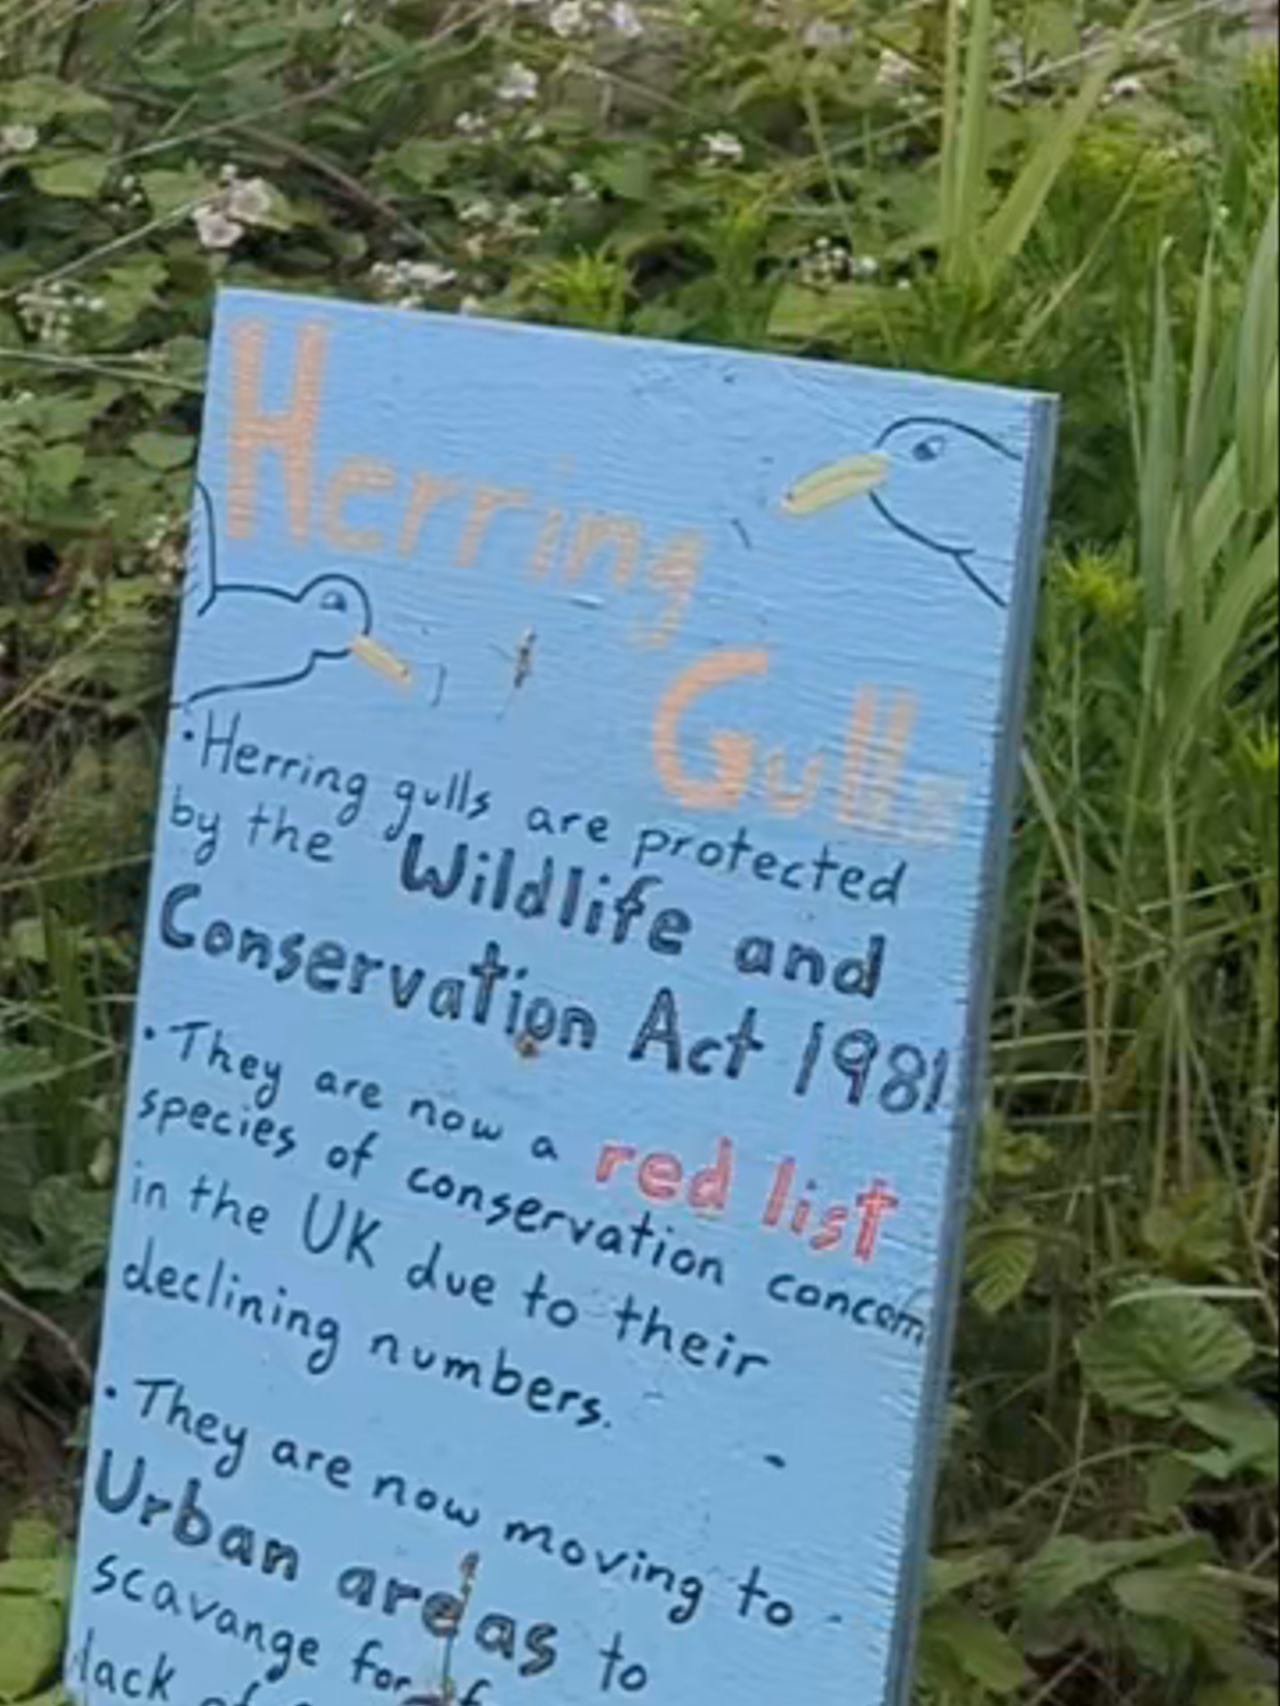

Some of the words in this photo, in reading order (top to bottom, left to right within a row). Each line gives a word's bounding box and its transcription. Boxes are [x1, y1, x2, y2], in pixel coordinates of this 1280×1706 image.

[223, 316, 706, 648] Herring
[168, 788, 221, 867] by
[246, 801, 336, 865] the
[396, 831, 693, 956] Wildlife
[733, 932, 887, 1001] and
[199, 712, 367, 828] Herring
[387, 769, 492, 840] gulls
[525, 805, 609, 845] are
[633, 822, 908, 906] protected
[157, 881, 597, 1051] Conservation
[628, 986, 766, 1081] Act
[791, 1019, 950, 1116] 1981
[134, 1083, 298, 1162] species
[326, 1132, 378, 1183] of
[406, 1163, 724, 1290] conservation
[169, 1020, 283, 1109] They
[314, 1070, 384, 1113] are
[408, 1095, 506, 1146] now
[529, 1133, 561, 1163] a
[594, 1136, 735, 1217] red
[760, 1154, 901, 1266] list
[120, 1241, 341, 1375] declining
[369, 1328, 614, 1431] numbers.
[130, 1162, 169, 1209] in
[188, 1163, 271, 1239] the
[301, 1191, 382, 1273] UK
[406, 1243, 497, 1309] due
[521, 1274, 580, 1332] to
[613, 1288, 771, 1381] their
[92, 1448, 303, 1583] Urban
[334, 1562, 561, 1677] areas
[598, 1631, 649, 1695] to
[132, 1377, 248, 1480] They
[271, 1438, 352, 1491] are
[373, 1473, 483, 1531] now
[503, 1516, 705, 1628] moving
[736, 1565, 796, 1631] to
[78, 1626, 177, 1703] lack
[91, 1552, 321, 1684] scavange
[350, 1639, 412, 1696] for
